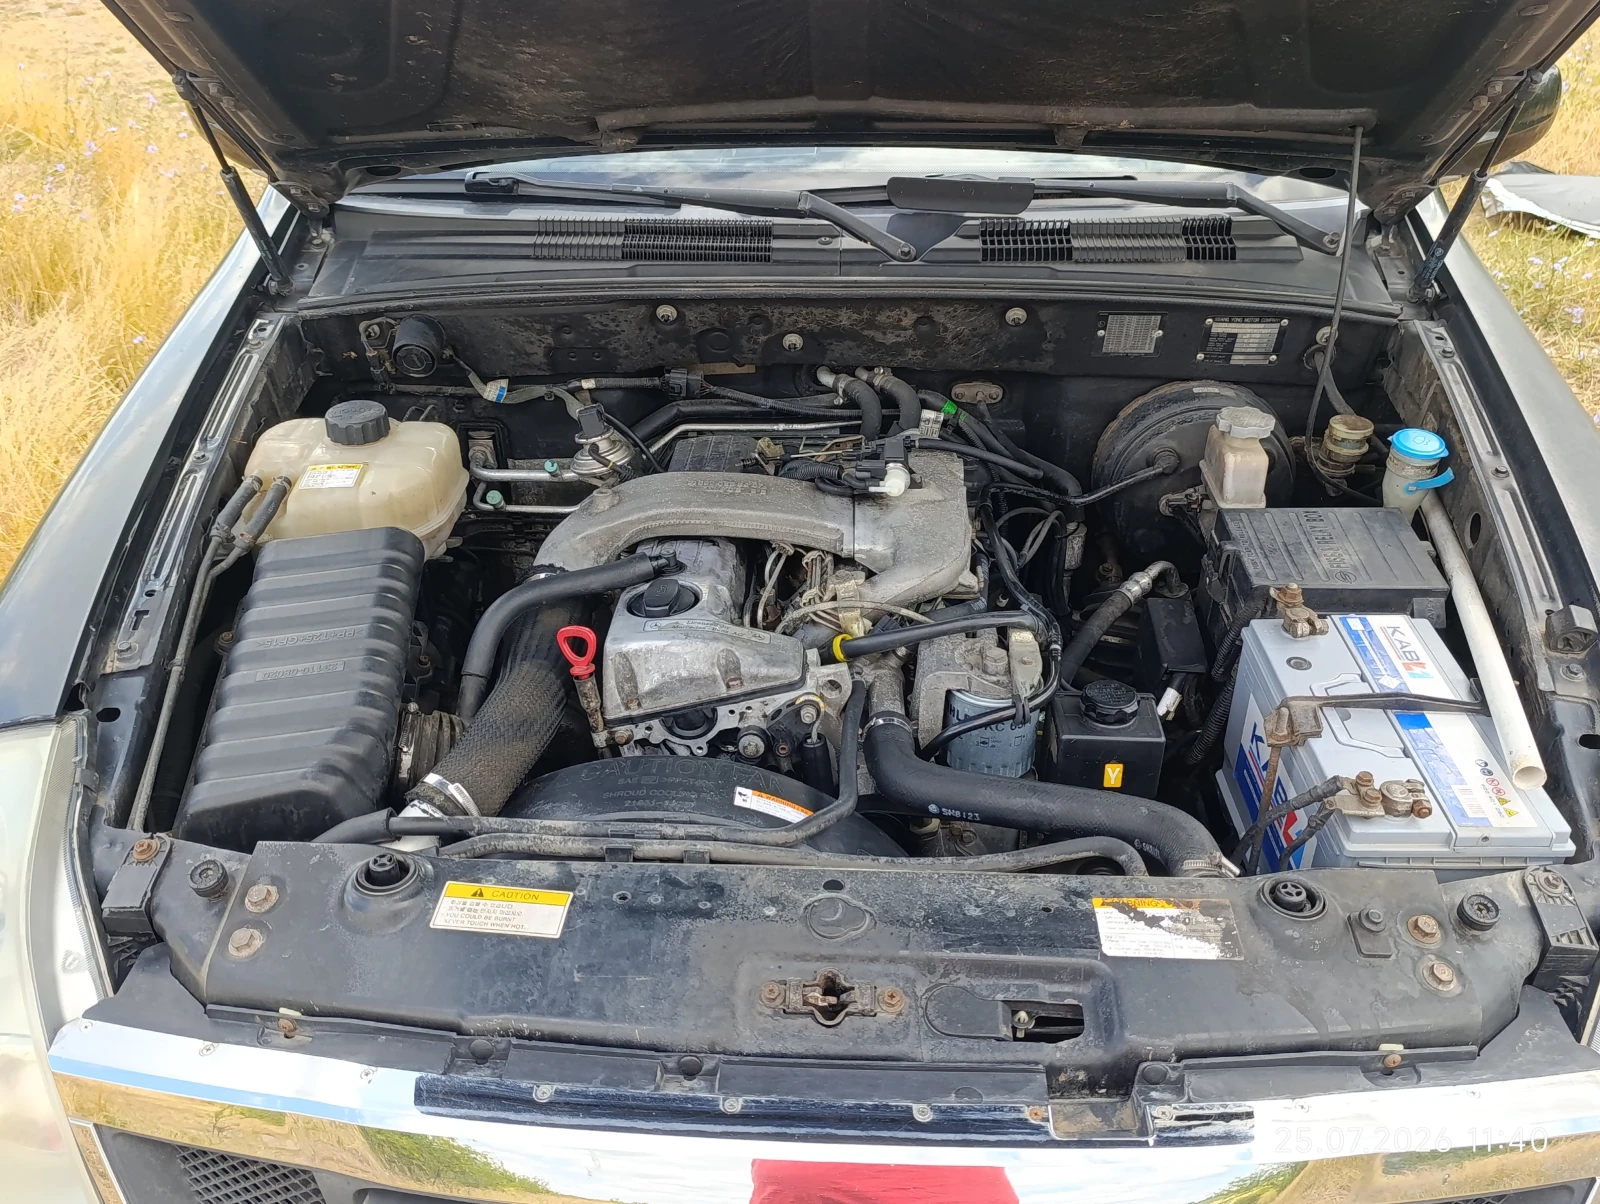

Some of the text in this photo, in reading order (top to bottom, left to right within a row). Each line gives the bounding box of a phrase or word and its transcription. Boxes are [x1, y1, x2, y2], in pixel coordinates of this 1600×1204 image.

[1302, 510, 1325, 522] BOX
[1309, 525, 1335, 544] RELAY
[581, 758, 721, 782] CAUTION
[1106, 767, 1122, 786] Y
[602, 789, 647, 799] SHROUD
[491, 890, 540, 901] CAUTION
[460, 912, 482, 920] COULD
[466, 919, 489, 927] TOUCH
[490, 921, 510, 929] WHEN
